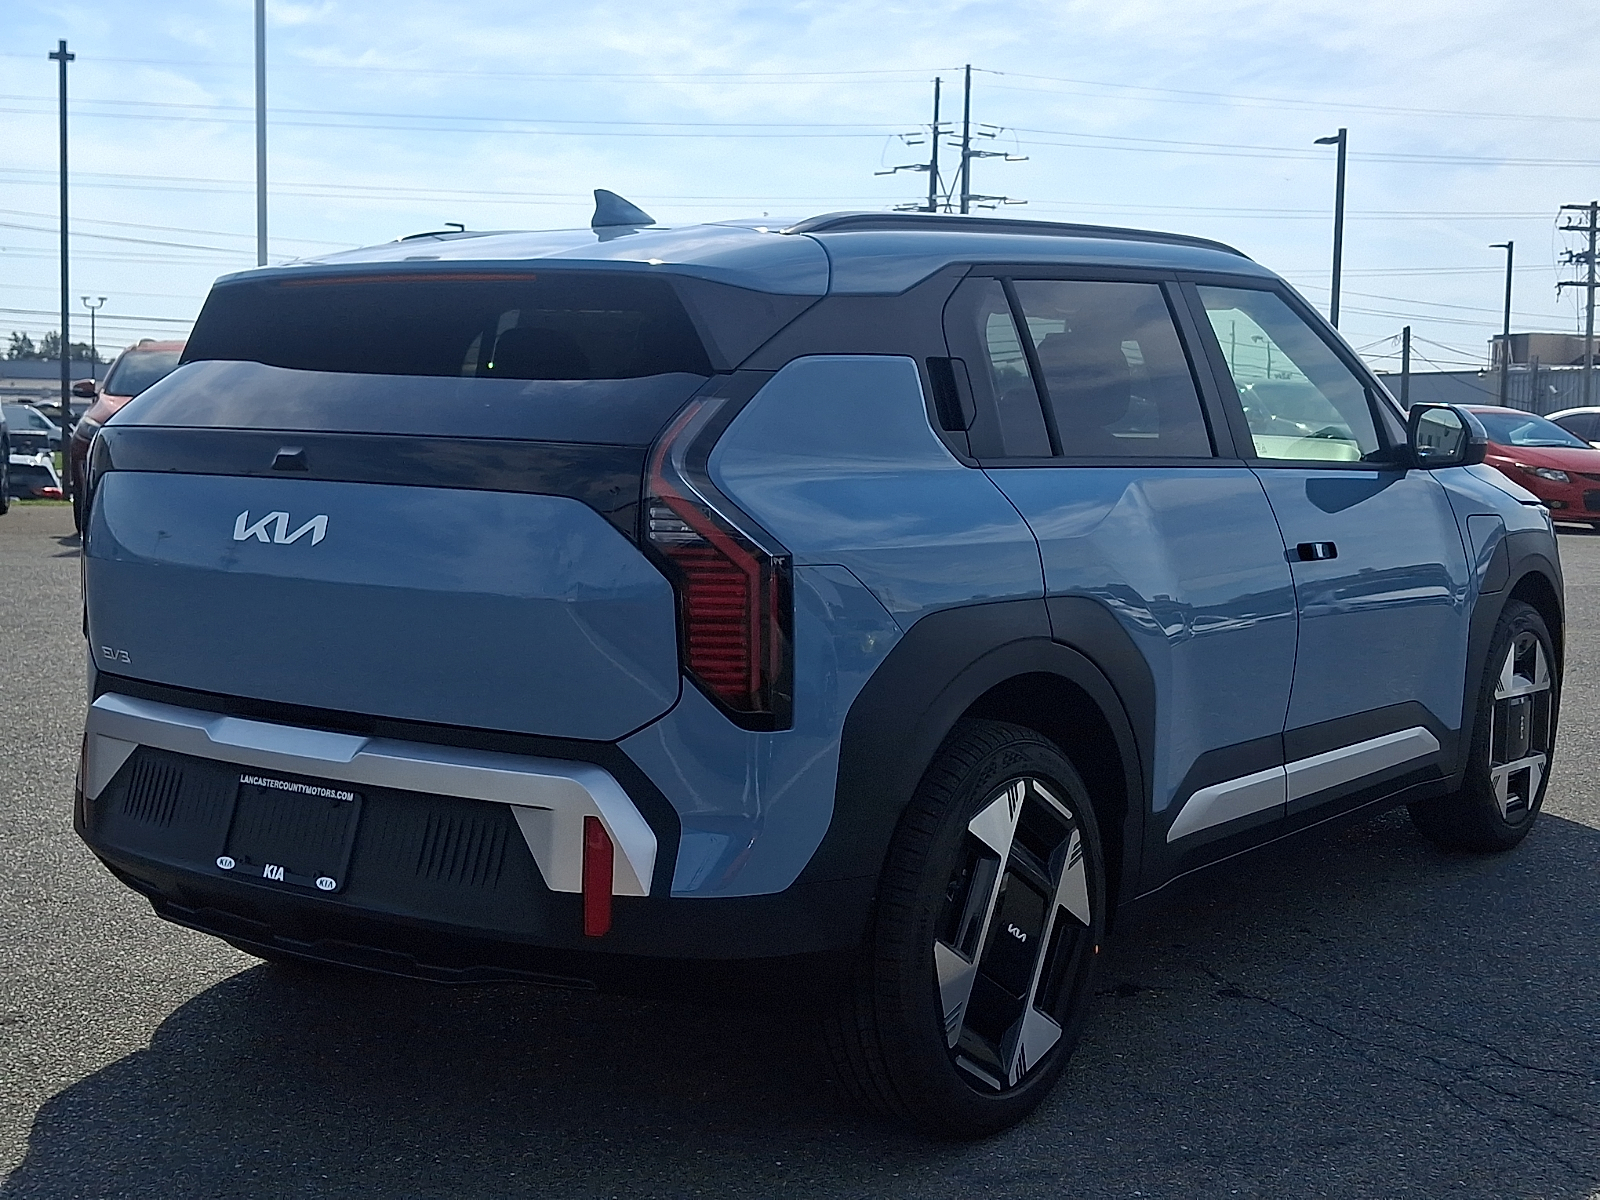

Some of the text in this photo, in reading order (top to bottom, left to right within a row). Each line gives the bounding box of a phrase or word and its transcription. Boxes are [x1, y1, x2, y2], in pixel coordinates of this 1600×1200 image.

[233, 509, 329, 547] KIA
[101, 645, 131, 664] EV3
[240, 774, 354, 802] LANCASTERCOUNTYMOTORS.COM
[218, 858, 233, 868] KIA
[263, 863, 284, 881] KIA
[318, 878, 334, 889] KIA
[1008, 923, 1027, 942] KIA
